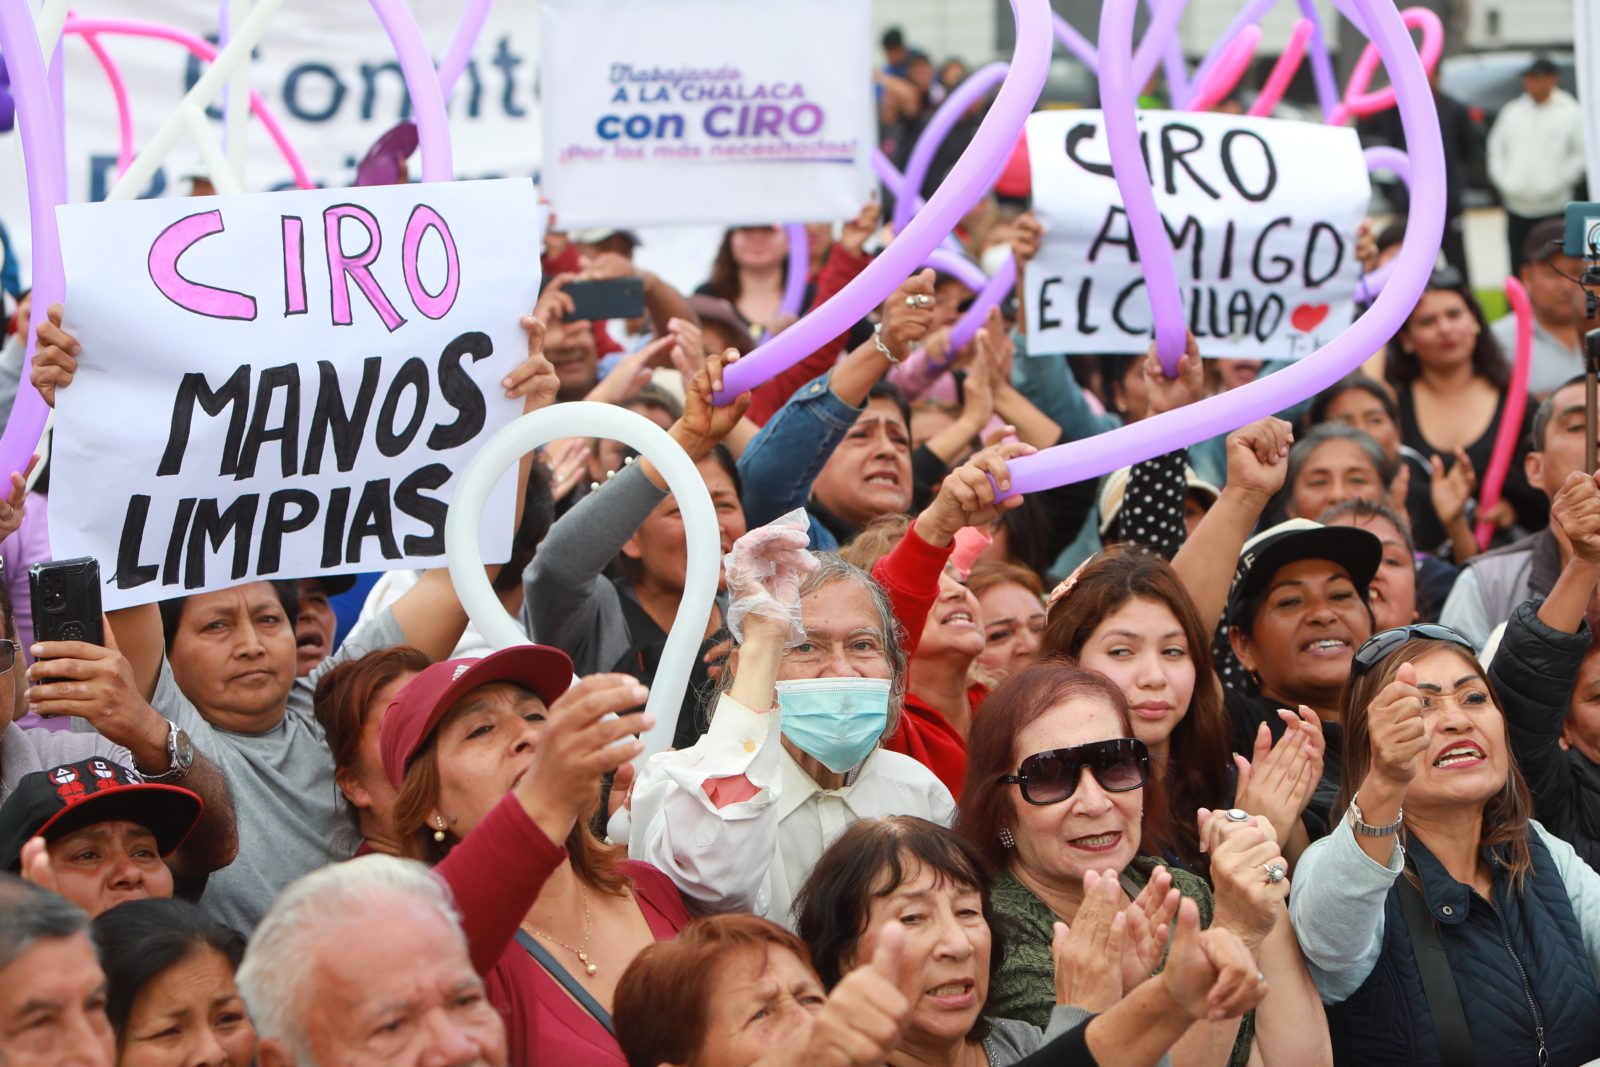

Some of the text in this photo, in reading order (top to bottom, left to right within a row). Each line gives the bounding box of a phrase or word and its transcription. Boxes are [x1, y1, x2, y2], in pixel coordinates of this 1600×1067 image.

[609, 63, 741, 87] Trabajando
[612, 83, 805, 103] A LA CHALACA
[595, 102, 825, 140] con CIRO
[147, 203, 460, 333] CIRO
[1087, 204, 1345, 289] AMIGO
[1038, 277, 1285, 343] EL CLLAO
[156, 331, 494, 481] MANOS
[106, 463, 453, 590] LIMPIAS
